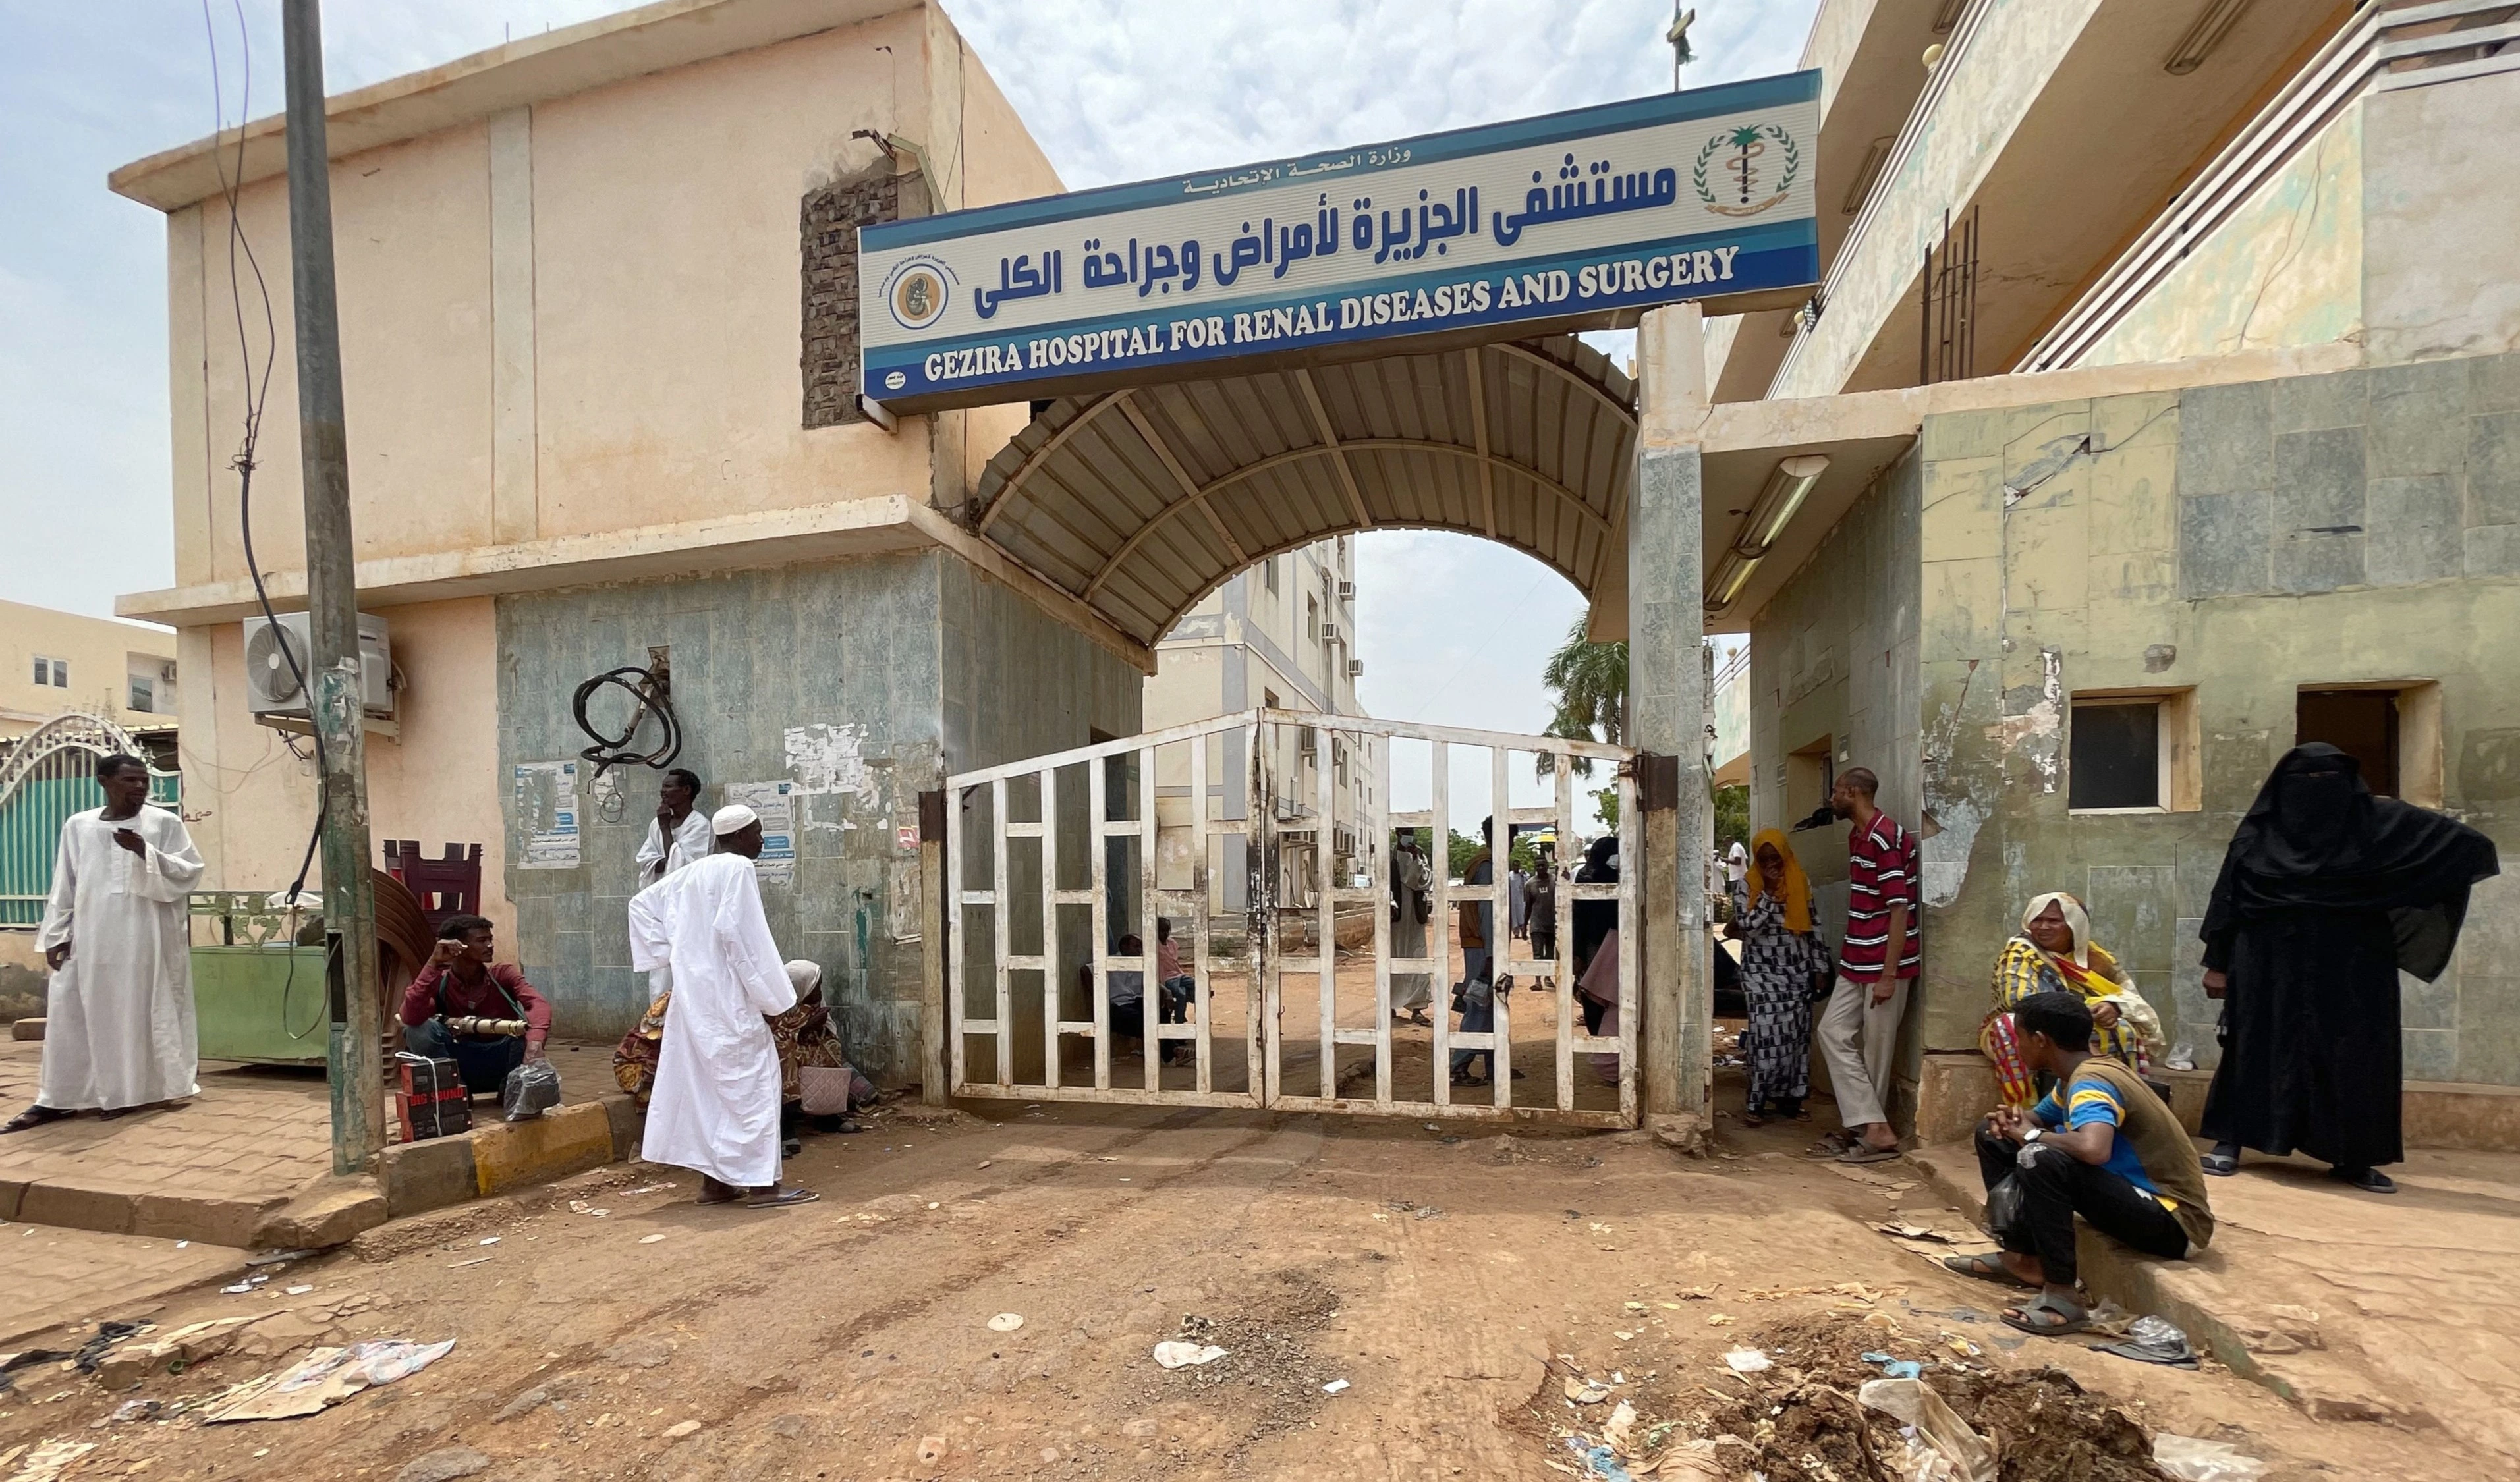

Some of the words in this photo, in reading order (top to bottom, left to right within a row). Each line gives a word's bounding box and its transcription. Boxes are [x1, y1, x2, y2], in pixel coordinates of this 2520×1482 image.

[1287, 154, 1362, 177] الصحة
[1368, 146, 1411, 166] وزارة
[1353, 186, 1478, 263] الجزيرة
[1493, 153, 1676, 246] مستشفى
[1083, 239, 1200, 297] وجراحة
[1213, 192, 1338, 287] لأمراض
[924, 343, 1023, 382] GEZIRA
[1028, 324, 1164, 369] HOSPITAL
[1169, 316, 1227, 351] FOR
[1233, 302, 1333, 343] RENAL
[1339, 281, 1490, 329] DISEASES
[1498, 270, 1571, 308] AND
[1578, 246, 1740, 298] SURGERY
[974, 248, 1062, 320] الكلى
